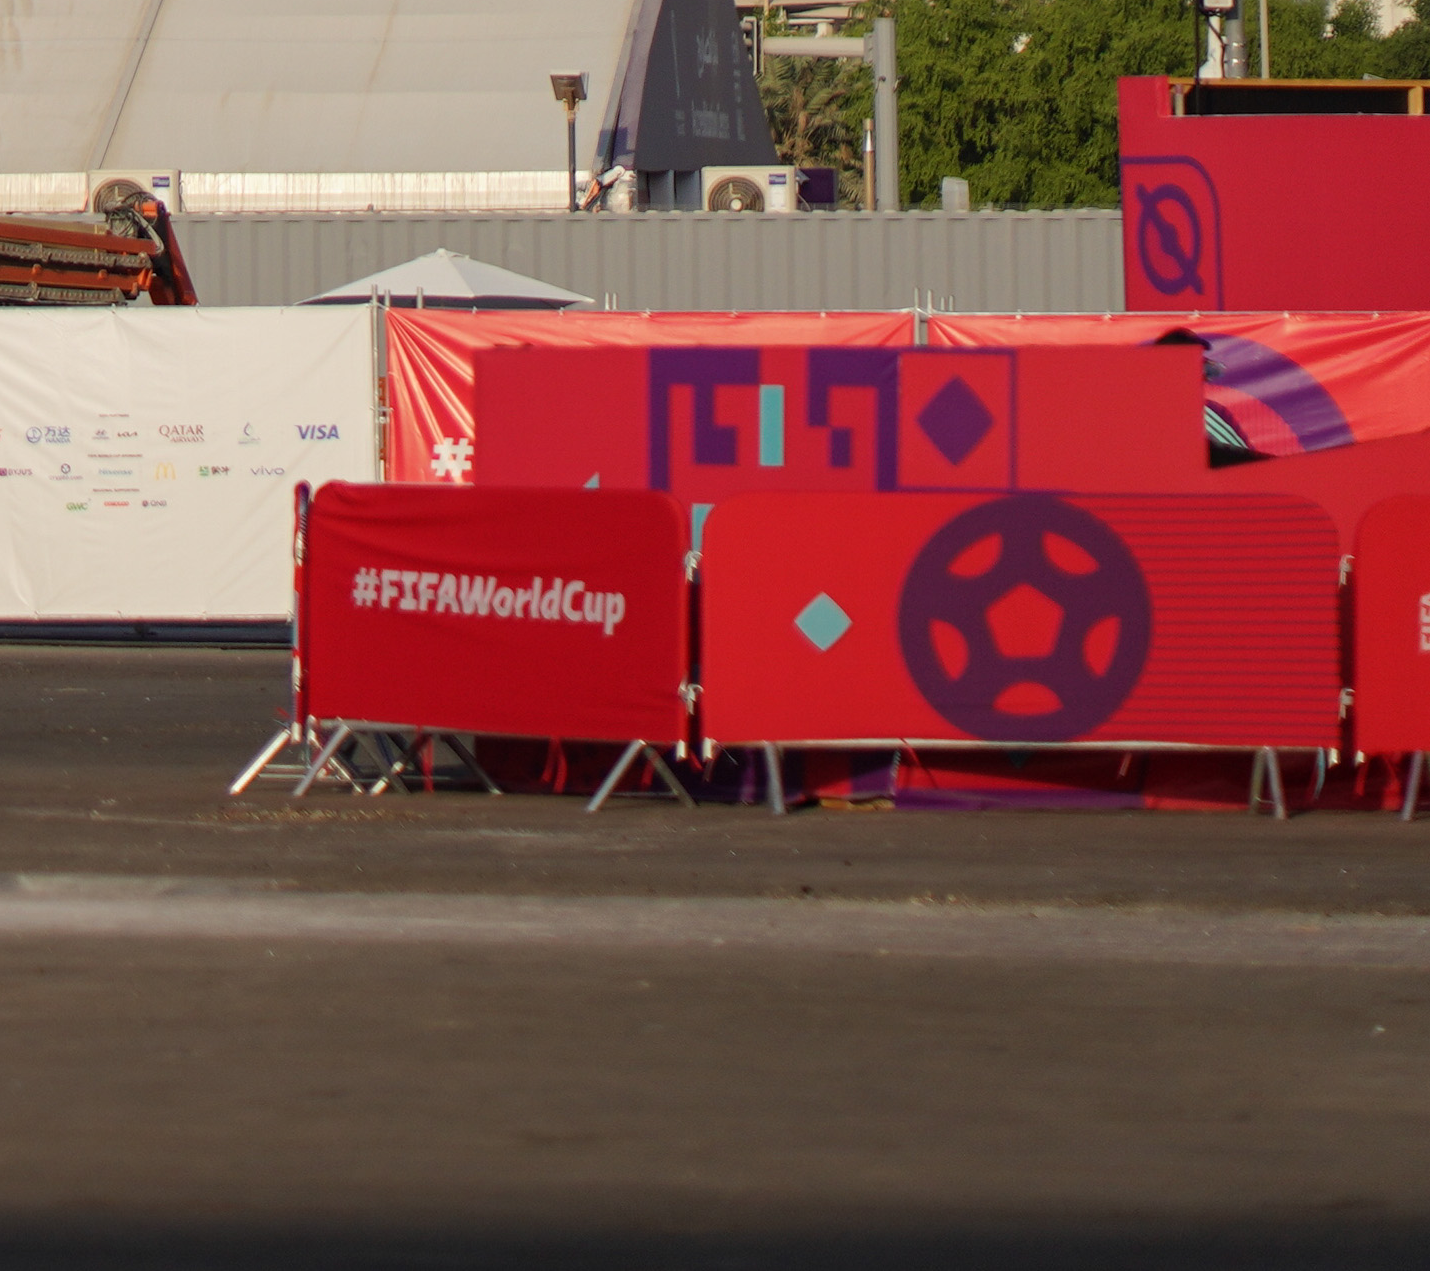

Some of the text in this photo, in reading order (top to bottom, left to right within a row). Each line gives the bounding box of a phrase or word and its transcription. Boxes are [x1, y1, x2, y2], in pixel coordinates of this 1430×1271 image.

[158, 424, 205, 437] QATAR
[294, 424, 340, 440] VISA
[250, 466, 286, 476] vivo
[352, 567, 627, 637] #FIFAWorldCup
